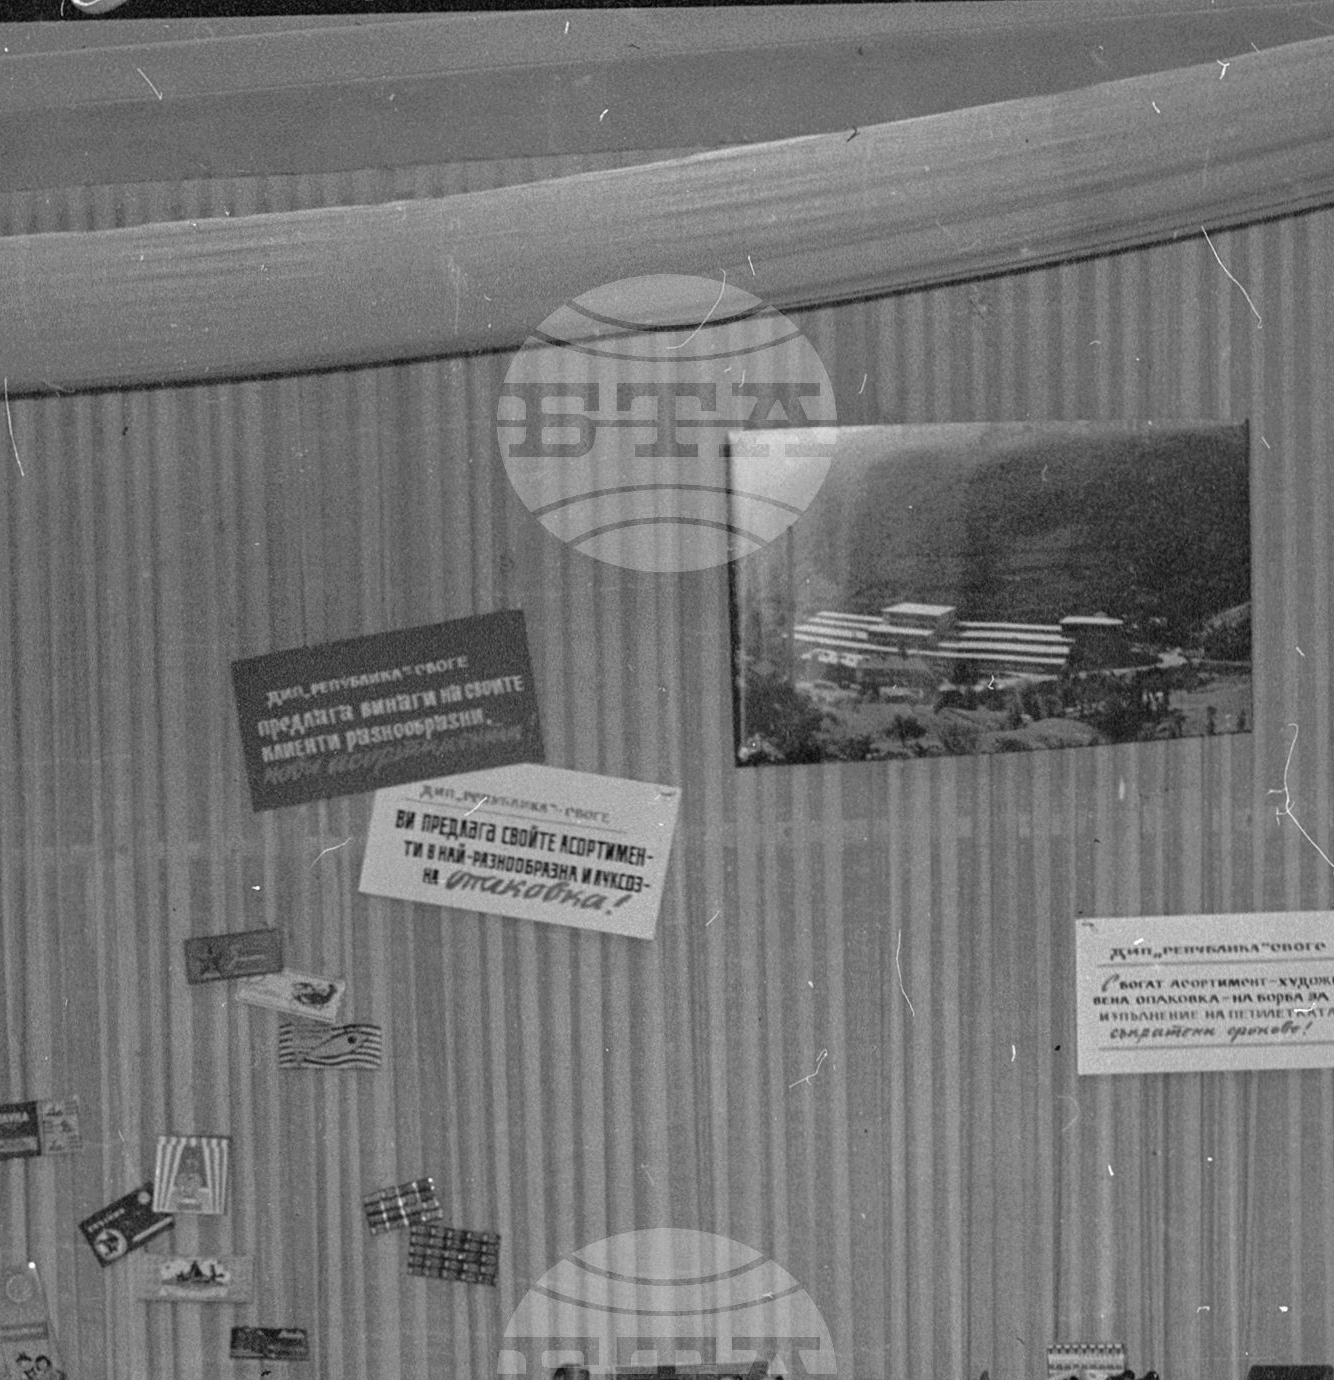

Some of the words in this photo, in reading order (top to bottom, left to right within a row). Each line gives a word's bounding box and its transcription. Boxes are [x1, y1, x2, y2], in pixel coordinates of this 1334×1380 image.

[395, 809, 416, 831] ВИ
[500, 821, 558, 852] СВОЙТЕ
[403, 841, 424, 858] ТИ
[581, 867, 592, 885] И
[422, 868, 440, 886] НА
[1119, 978, 1164, 991] БОГАТ
[1093, 994, 1129, 1006] ВЕНА
[1257, 991, 1303, 1007] БОРБА
[1307, 992, 1329, 1003] ЗА
